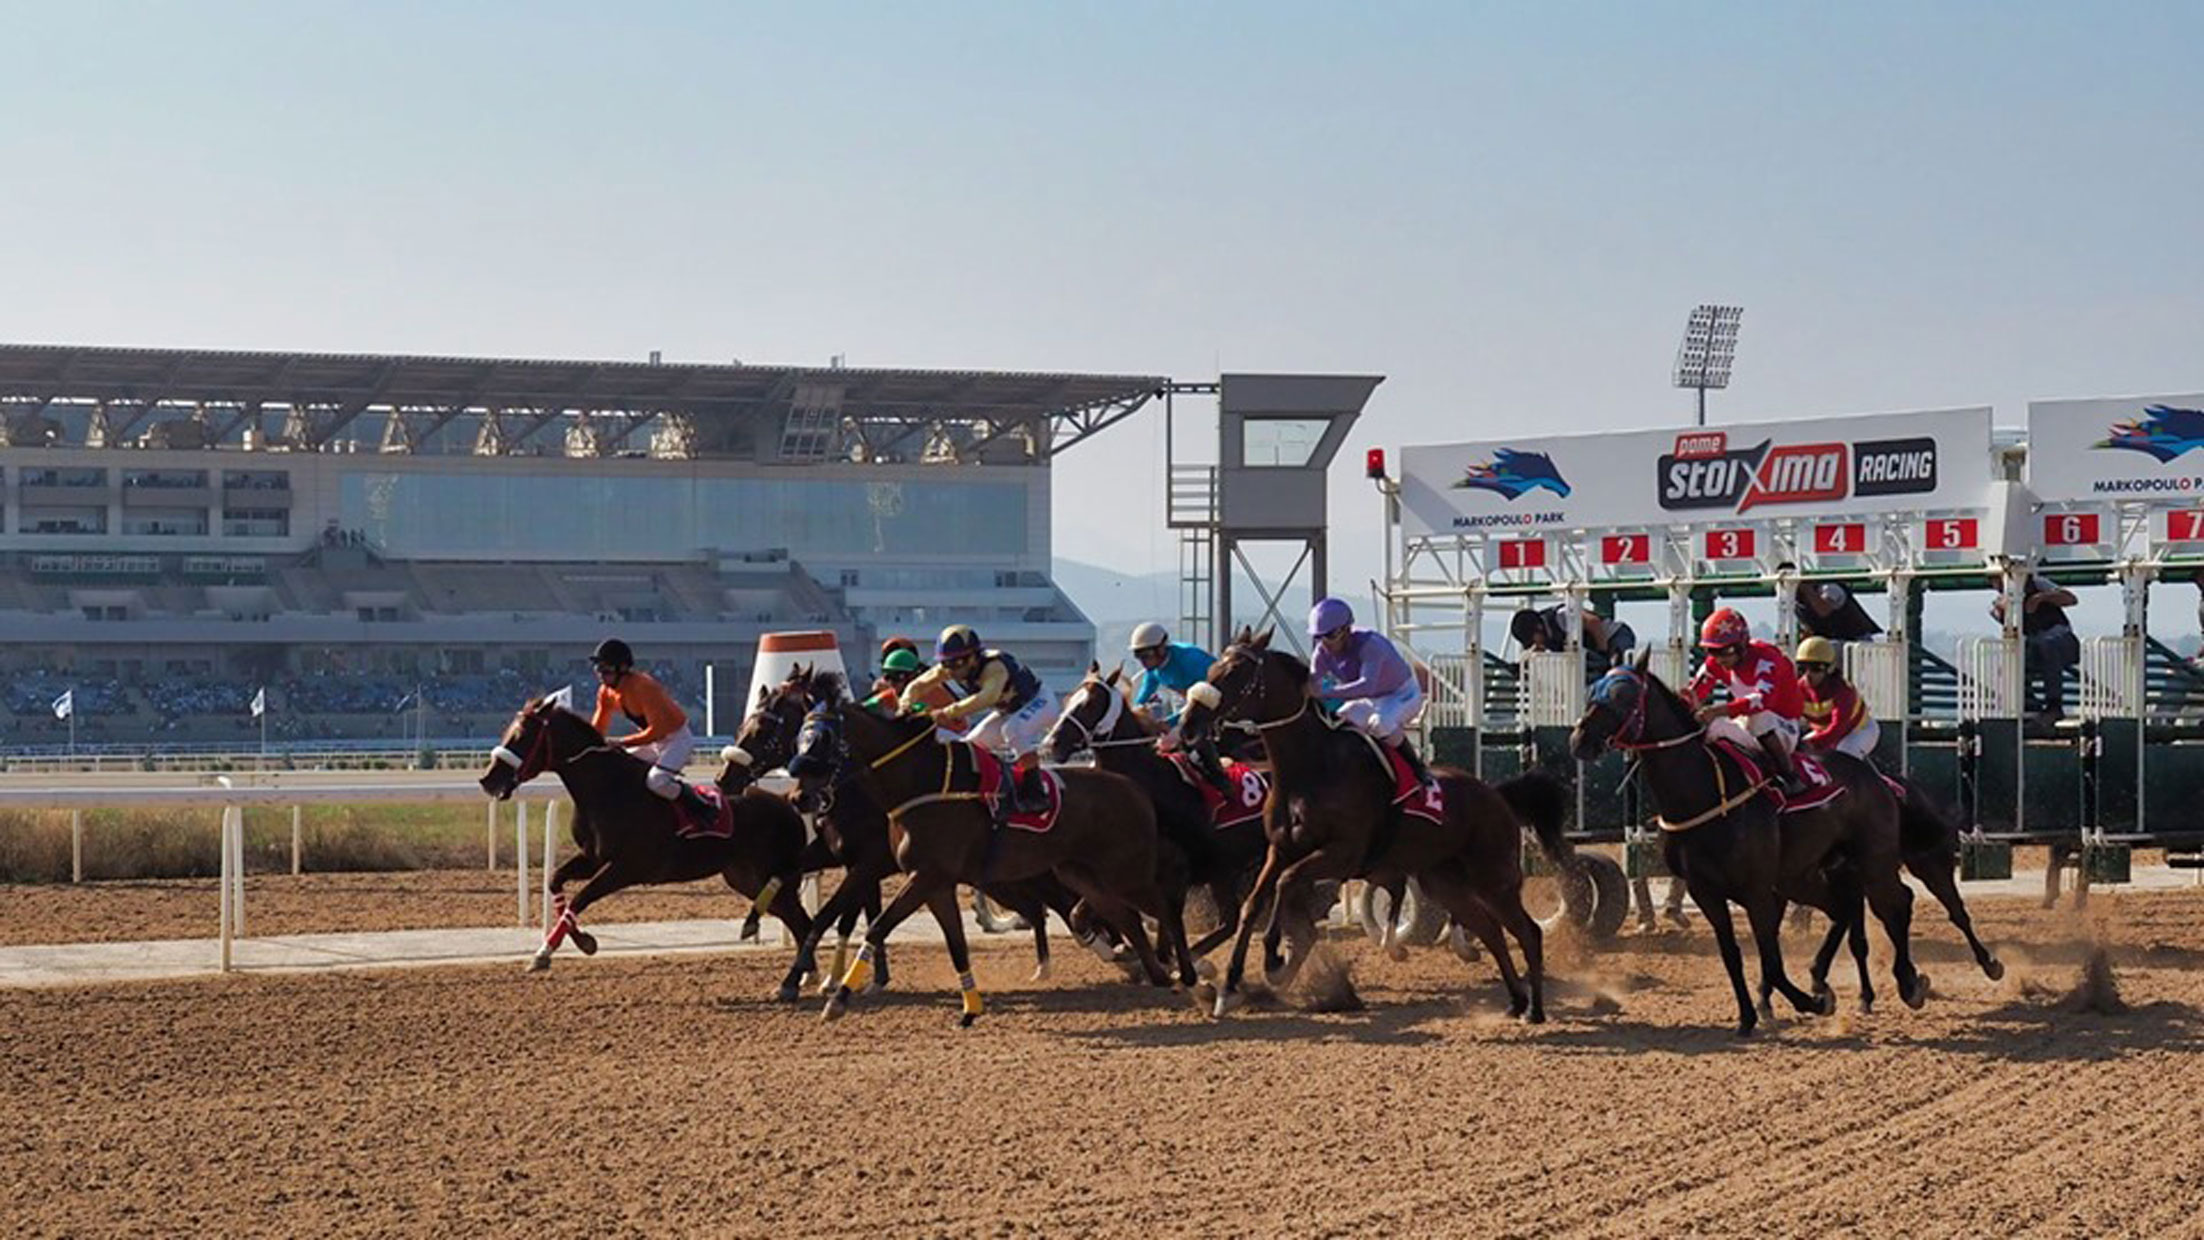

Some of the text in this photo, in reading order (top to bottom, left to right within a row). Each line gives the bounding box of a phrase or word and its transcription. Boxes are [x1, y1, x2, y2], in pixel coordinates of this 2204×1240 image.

[1859, 451, 1933, 482] RACING
[2093, 477, 2204, 492] MARKOPOULO P
[1453, 511, 1565, 527] MARKOPOULO PARK
[2062, 516, 2081, 543] 6
[1721, 531, 1739, 558] 3
[1829, 525, 1847, 552] 4
[1943, 520, 1961, 547] 5
[1514, 542, 1525, 567] 1
[1617, 536, 1634, 563] 2
[1242, 771, 1263, 808] 8
